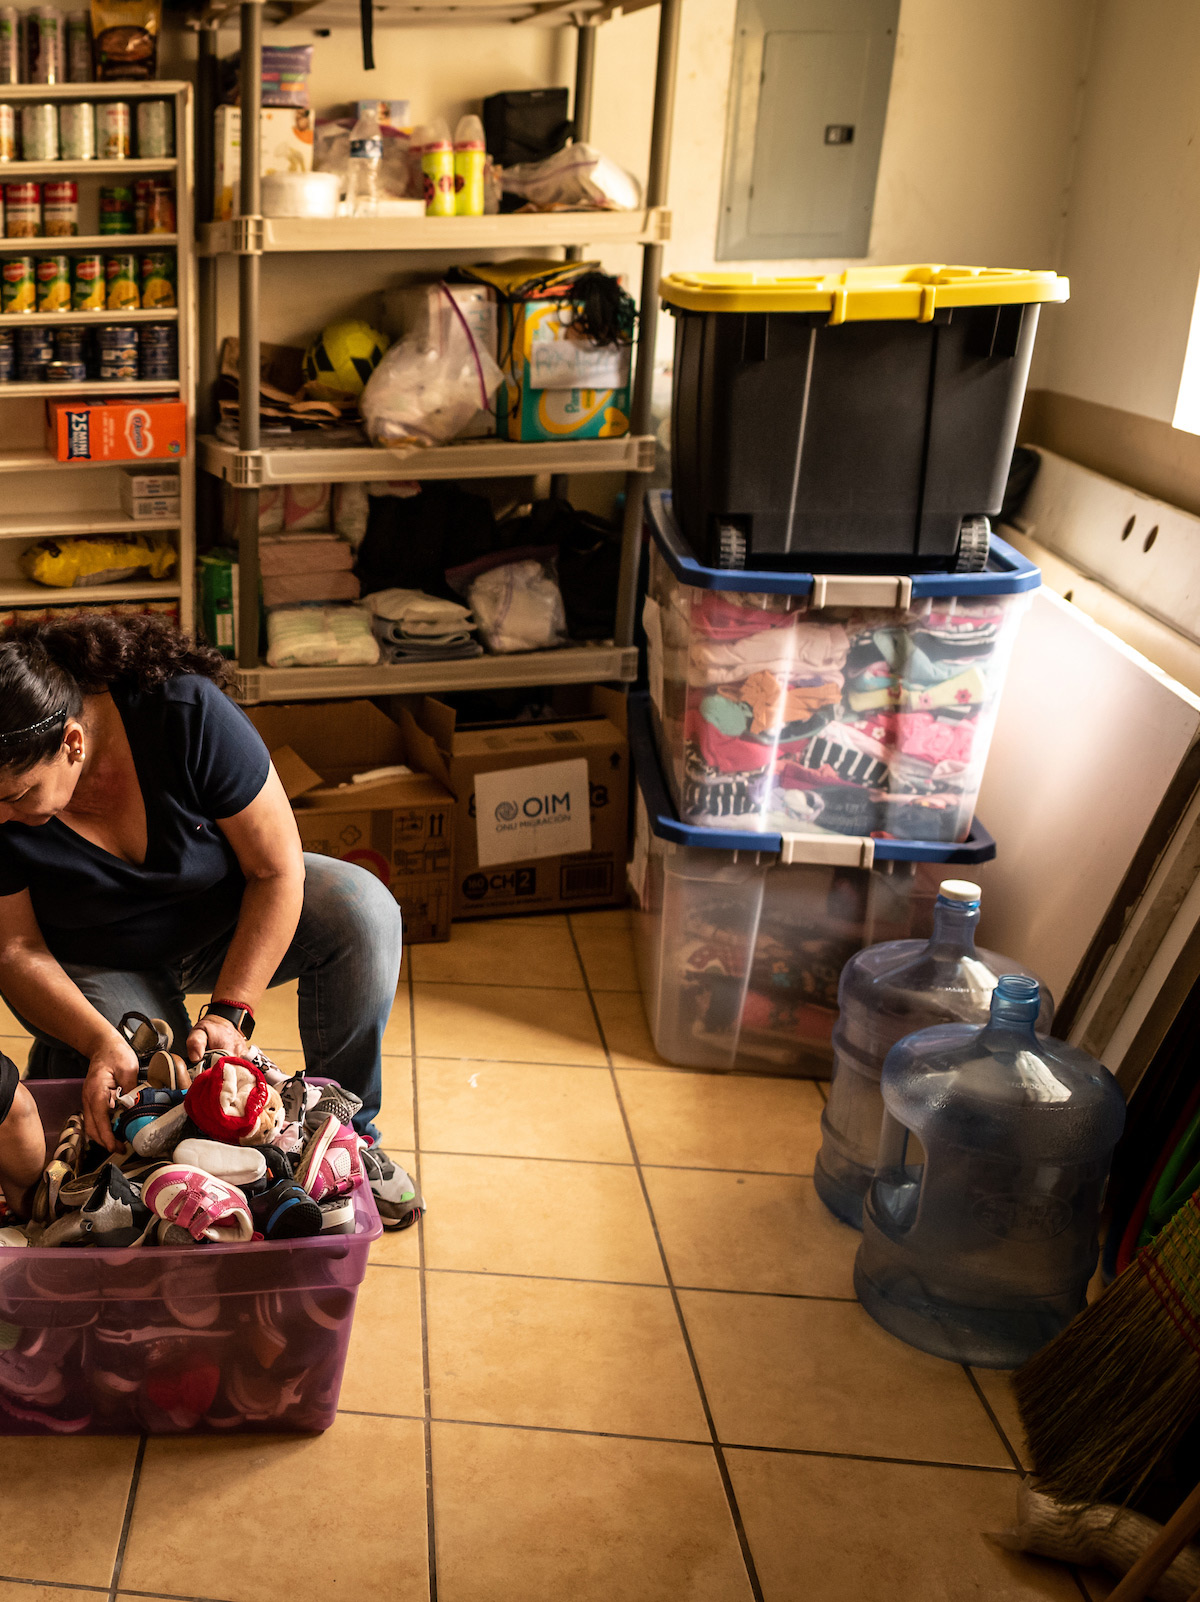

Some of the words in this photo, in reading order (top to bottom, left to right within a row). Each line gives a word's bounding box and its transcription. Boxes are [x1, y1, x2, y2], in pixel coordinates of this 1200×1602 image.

[71, 413, 88, 431] 25
[79, 431, 88, 456] MINI
[523, 792, 571, 818] OIM
[496, 821, 517, 833] ONU
